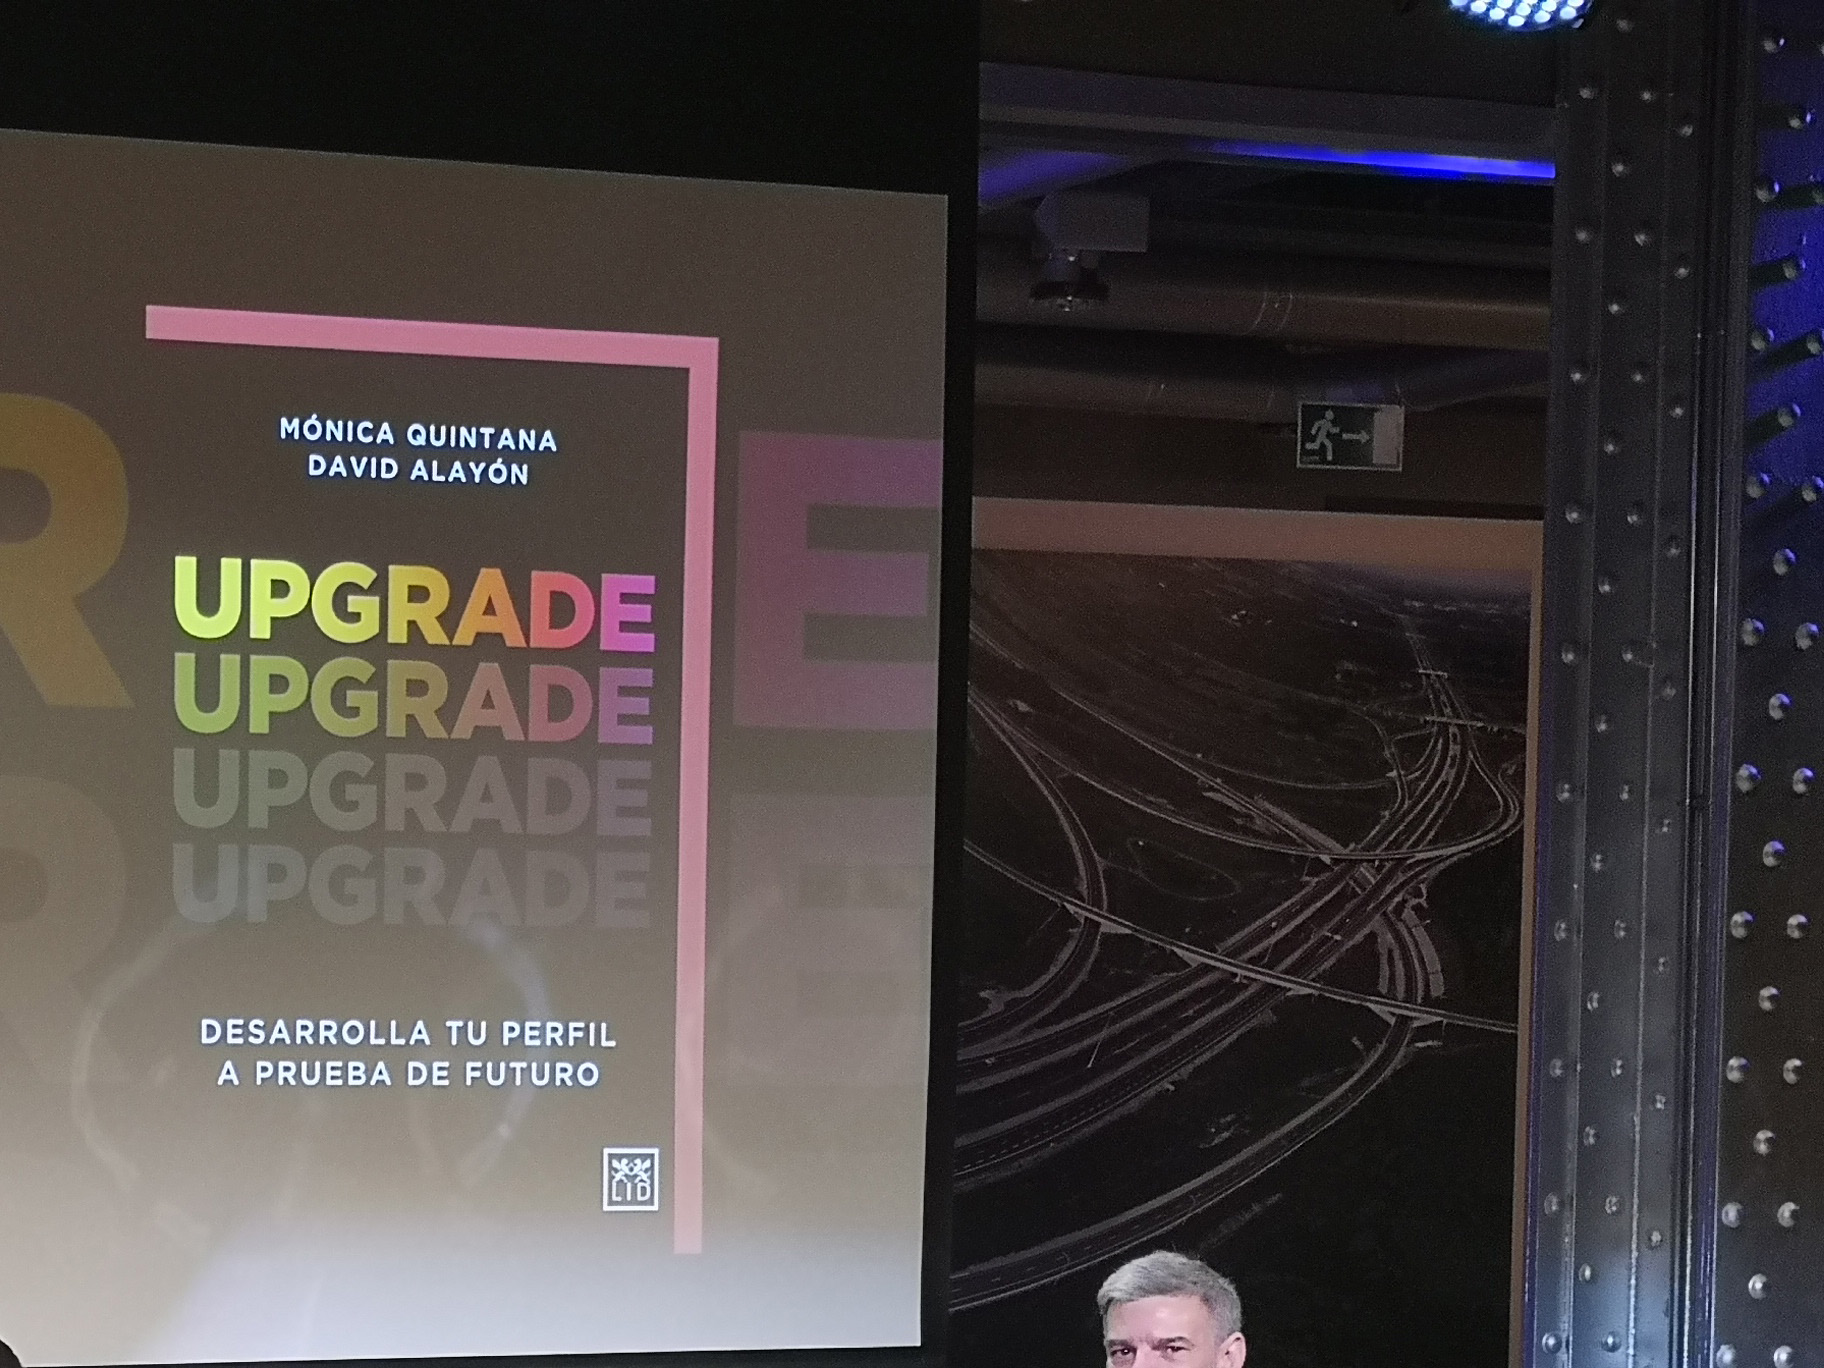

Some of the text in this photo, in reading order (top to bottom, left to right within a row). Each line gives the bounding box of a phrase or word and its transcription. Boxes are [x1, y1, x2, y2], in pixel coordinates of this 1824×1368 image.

[279, 412, 558, 453] MÓNICA QUINTANA
[307, 452, 530, 487] DAVID ALAYÓN
[174, 555, 657, 653] UPGRADE
[174, 652, 655, 745] UPGRADE
[174, 747, 653, 837] UPGRADE
[173, 843, 653, 928] UPGRADE
[200, 1017, 618, 1048] DESARROLLA TU PERFIL
[216, 1060, 601, 1088] A PRUEBA DE FUTURO
[610, 1180, 652, 1202] LID
